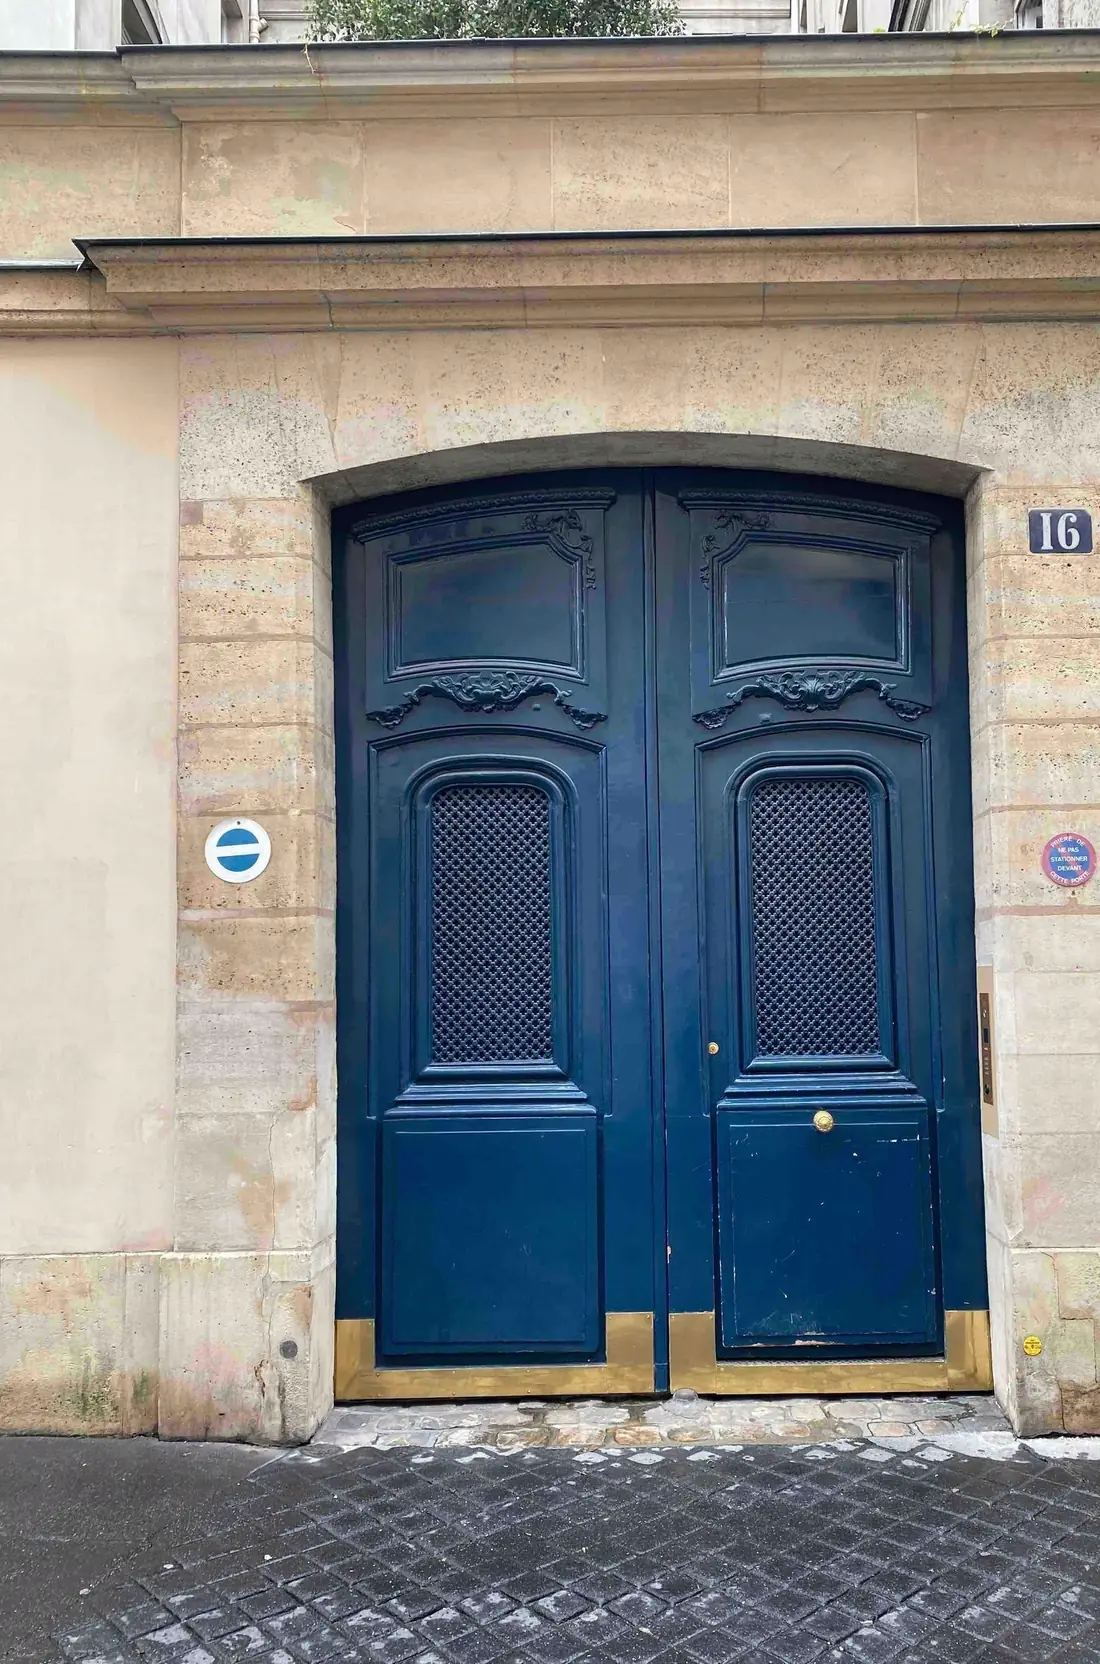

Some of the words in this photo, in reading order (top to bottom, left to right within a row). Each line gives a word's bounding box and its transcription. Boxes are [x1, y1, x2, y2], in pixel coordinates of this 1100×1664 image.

[1040, 512, 1080, 550] 16
[1076, 839, 1085, 847] DE
[1050, 871, 1068, 883] CETTE
[1071, 871, 1090, 883] PORTE
